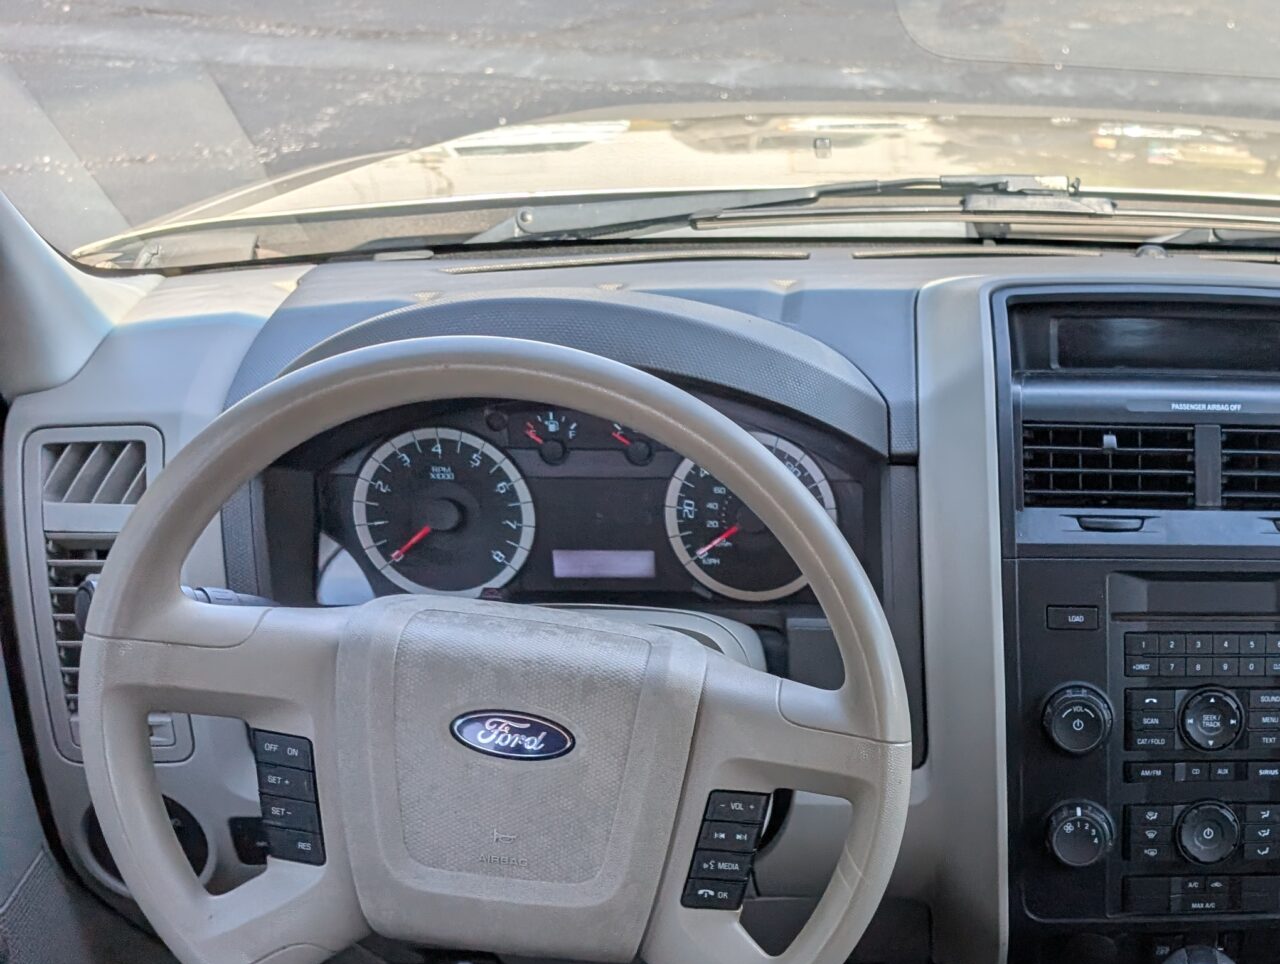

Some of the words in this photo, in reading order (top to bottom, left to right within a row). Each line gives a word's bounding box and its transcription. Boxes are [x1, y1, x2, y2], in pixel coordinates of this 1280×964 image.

[1171, 403, 1206, 411] PASSENGER
[568, 430, 577, 439] F
[431, 444, 442, 455] 4
[399, 453, 411, 467] 3
[471, 453, 482, 467] 5
[375, 481, 390, 492] 2
[496, 482, 509, 493] 6
[683, 500, 695, 518] 20
[706, 502, 719, 510] 40
[706, 520, 719, 528] 20
[492, 551, 505, 562] 8
[476, 718, 548, 751] Ford
[264, 742, 279, 752] OFF
[286, 747, 299, 756] ON
[267, 775, 282, 784] SET
[271, 806, 285, 816] SET
[730, 802, 744, 811] VOL
[297, 841, 312, 851] RES
[717, 861, 740, 870] MEDIA
[717, 891, 728, 899] OK
